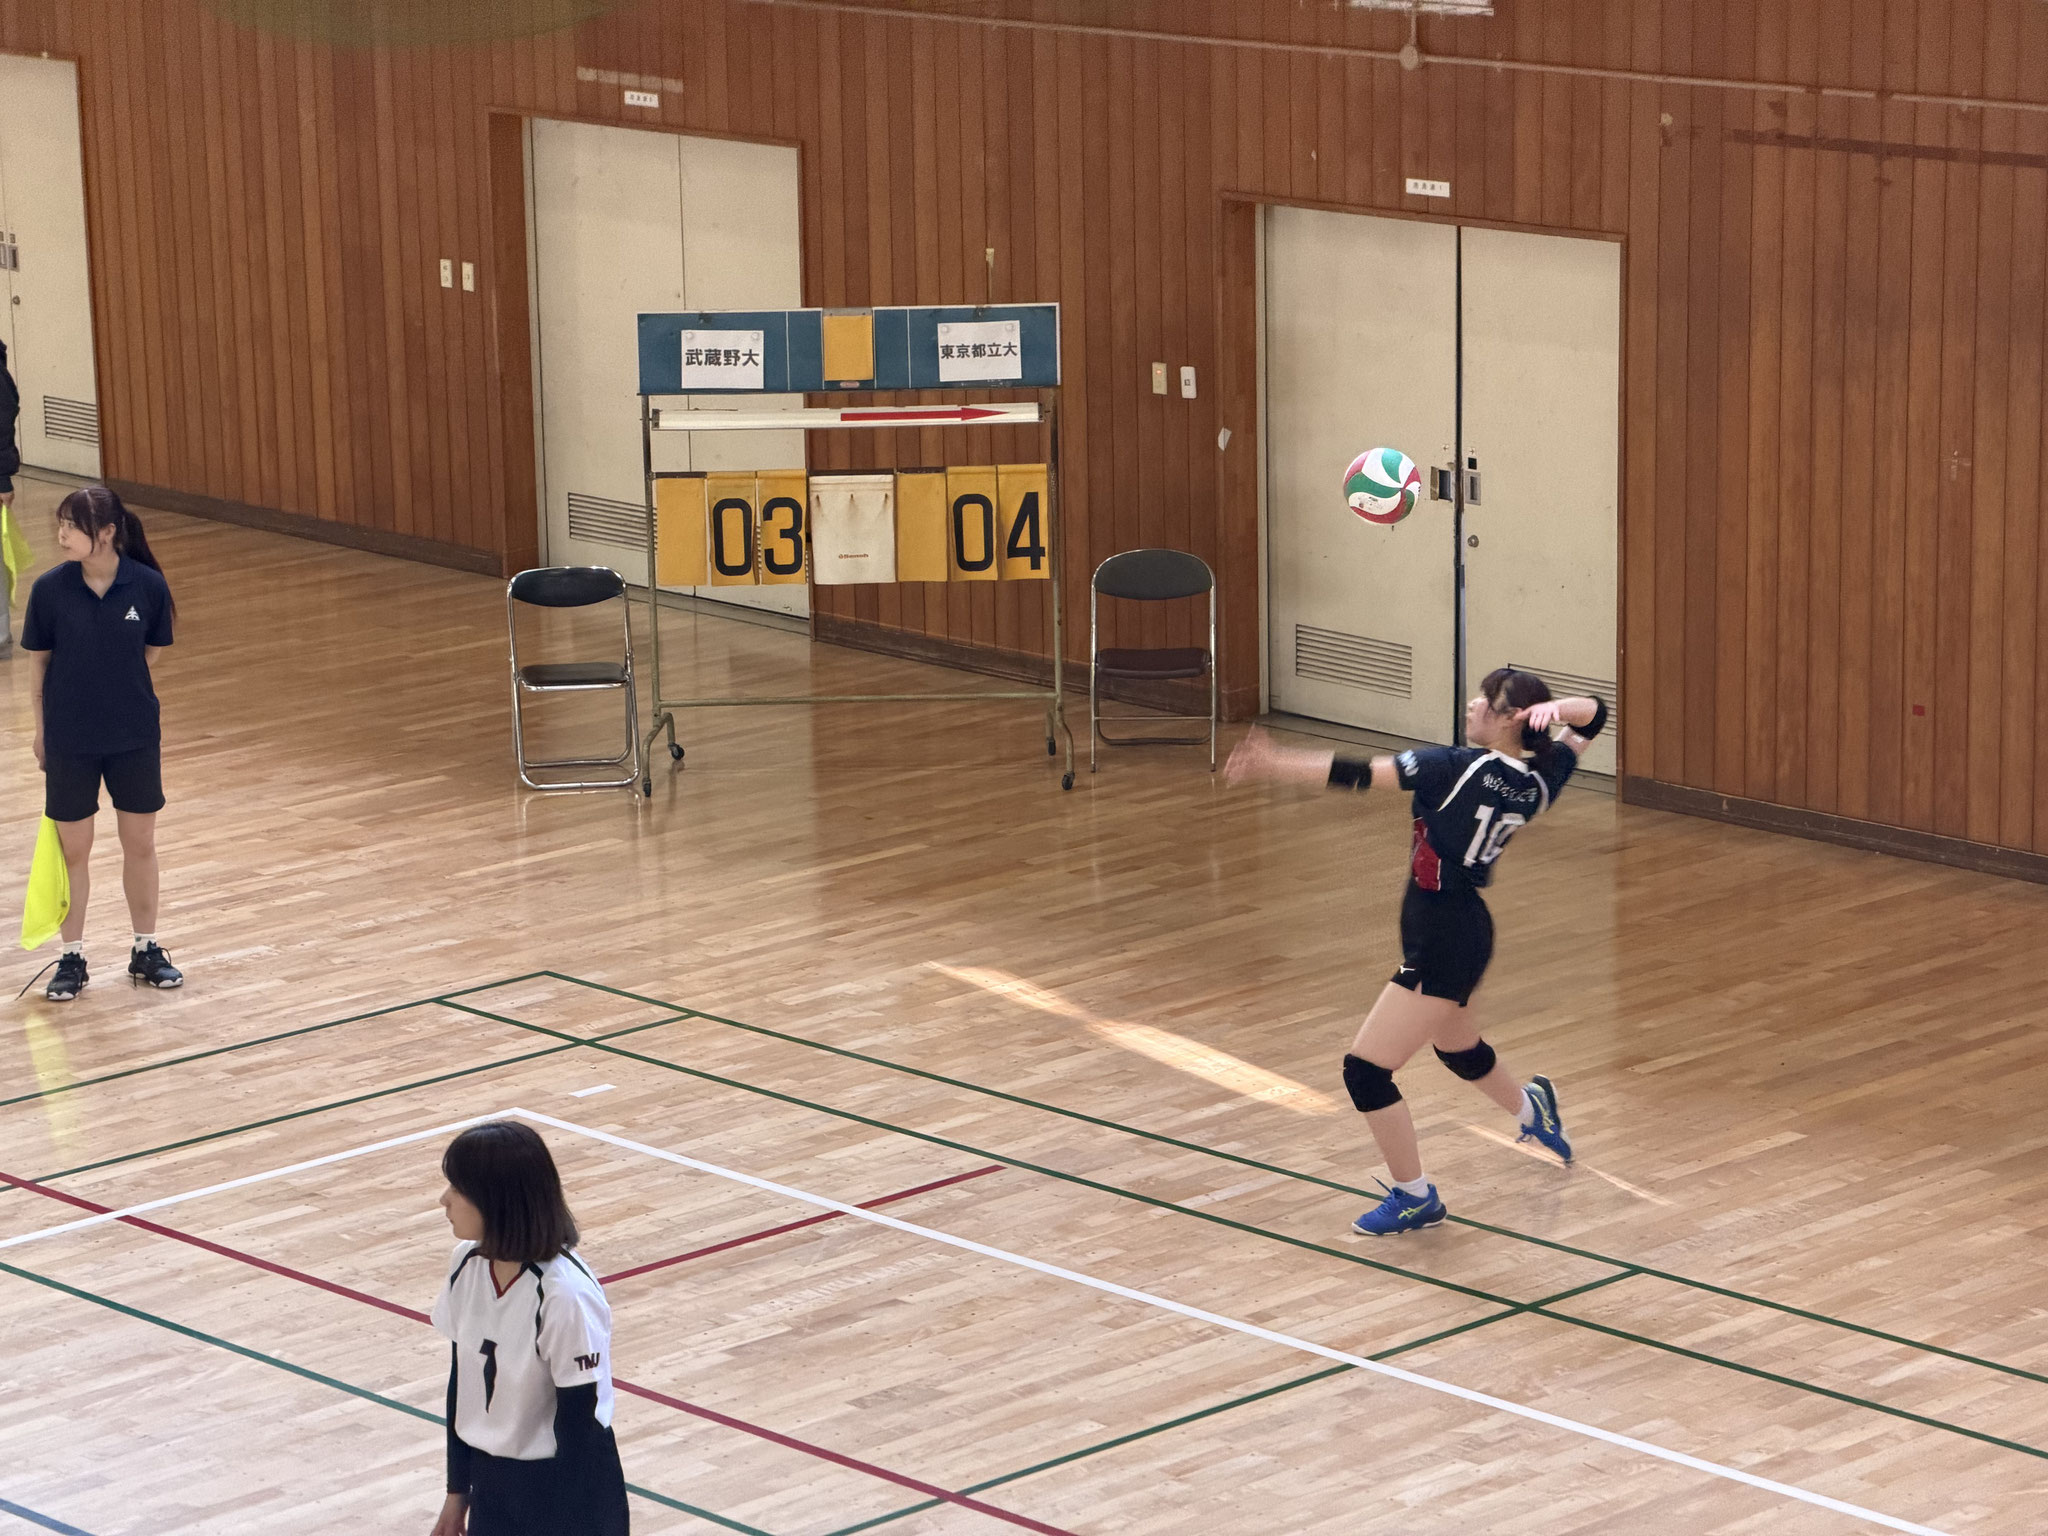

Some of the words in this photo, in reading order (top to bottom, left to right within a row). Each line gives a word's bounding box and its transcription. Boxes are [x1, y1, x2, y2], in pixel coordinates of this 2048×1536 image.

[685, 347, 760, 367] 武蔵野大
[940, 342, 1018, 360] 東京都立大
[712, 497, 804, 576] 03
[953, 491, 1046, 572] 04
[479, 1338, 498, 1414] 1
